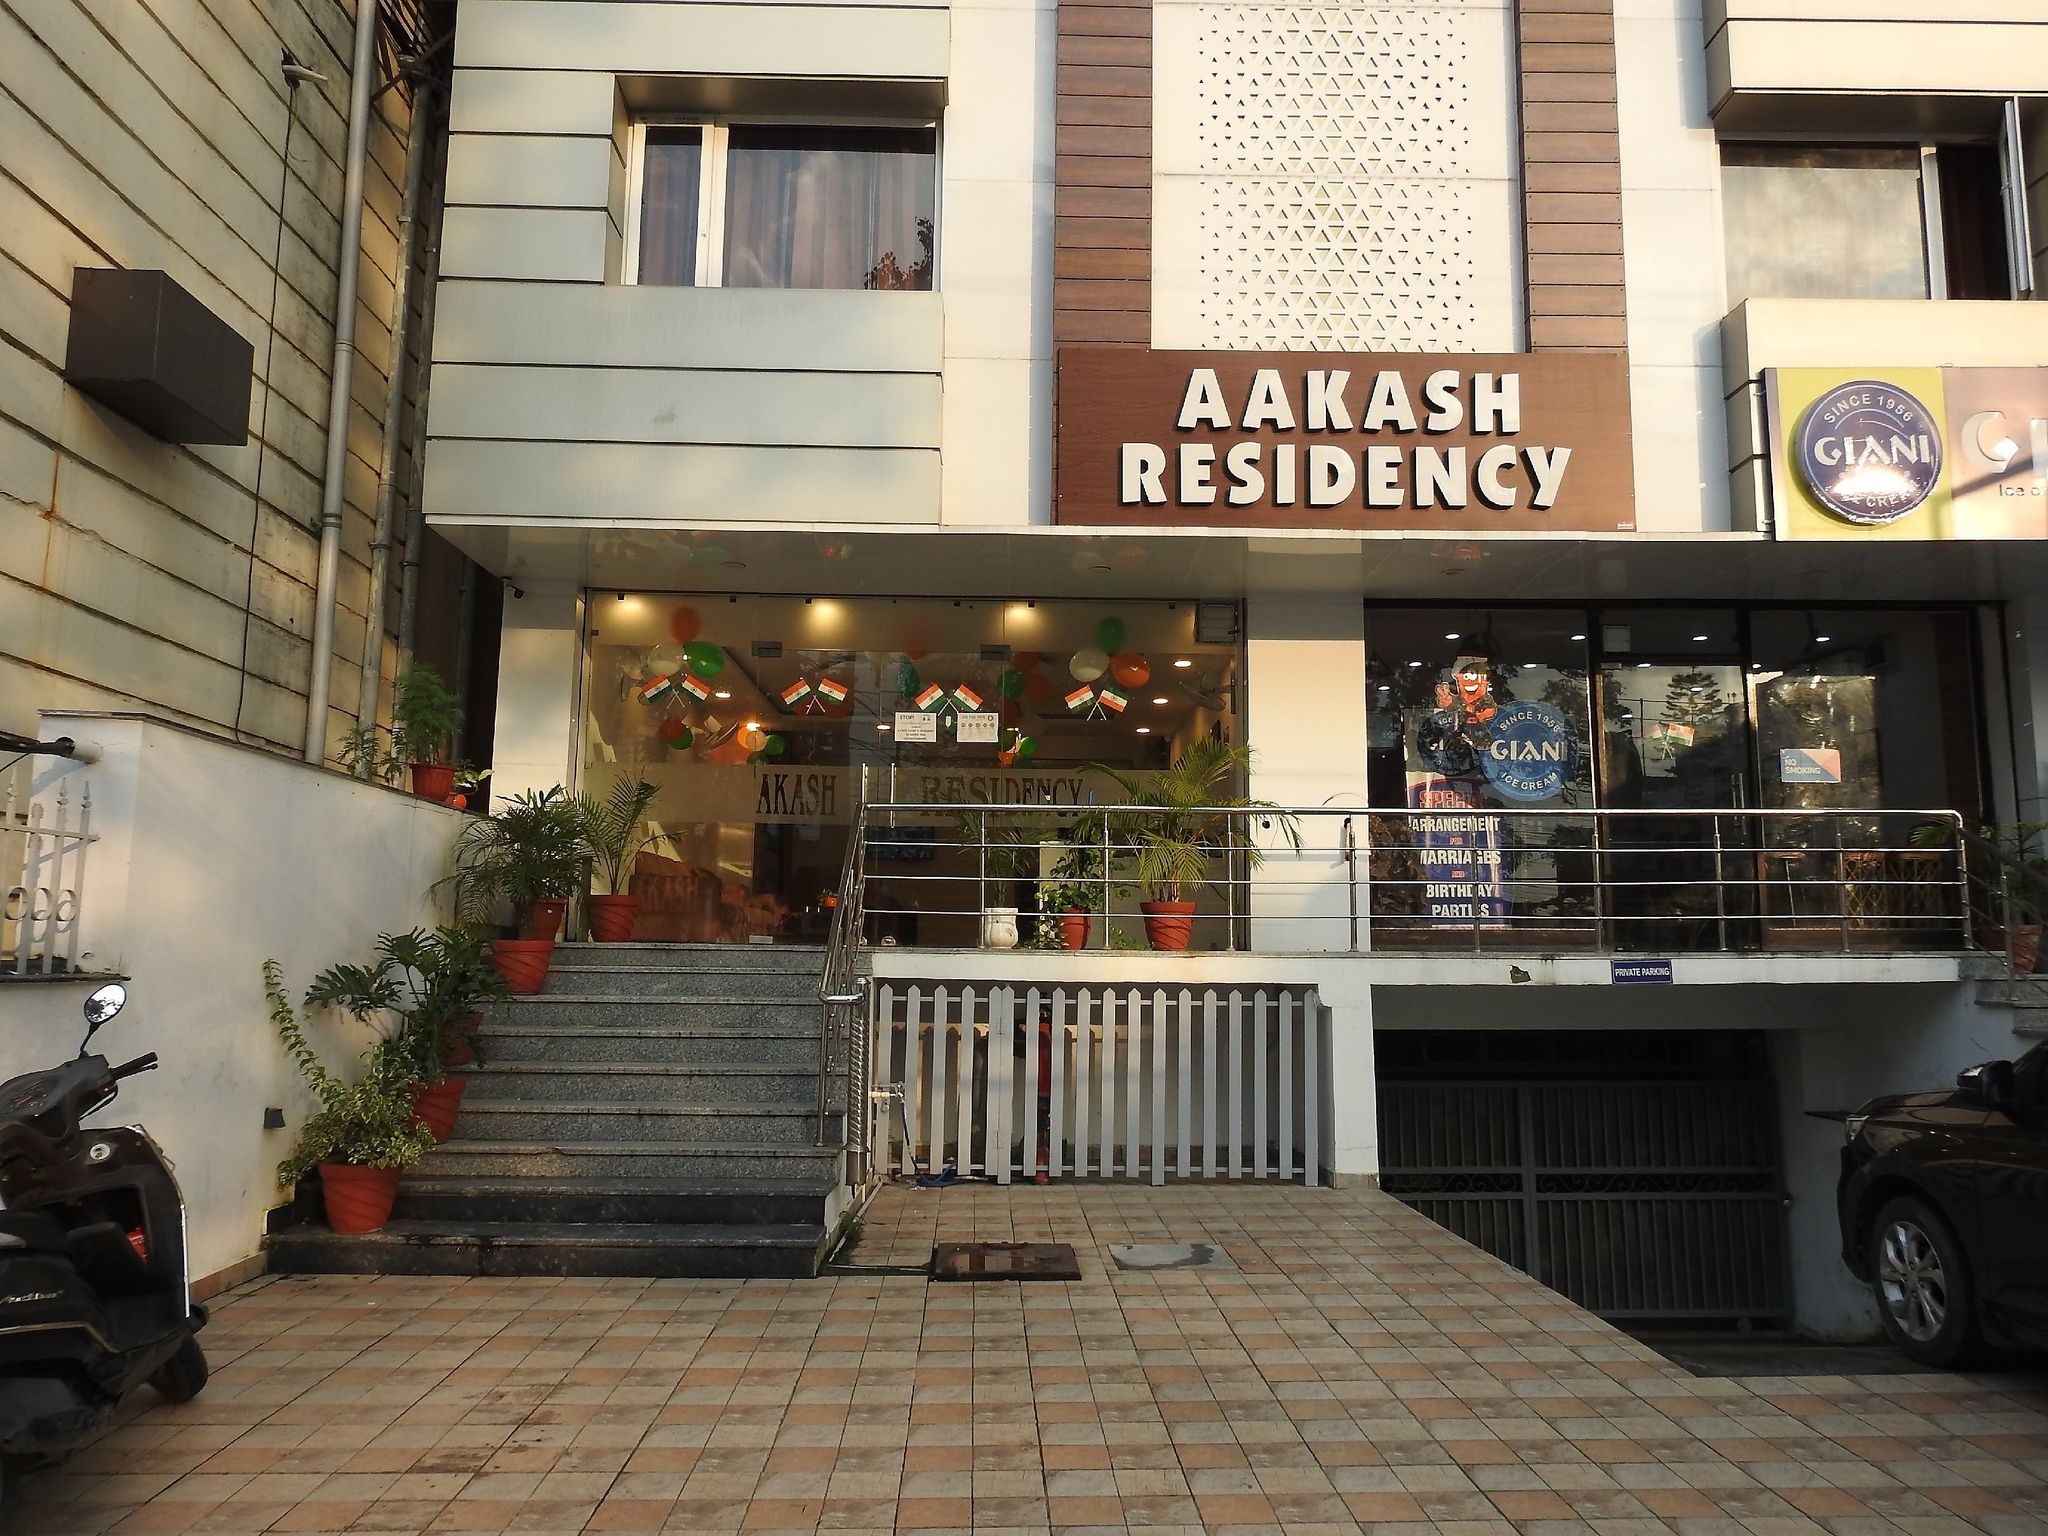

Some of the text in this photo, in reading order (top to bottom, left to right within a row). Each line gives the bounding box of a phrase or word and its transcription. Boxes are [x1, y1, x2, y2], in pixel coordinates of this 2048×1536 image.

[1177, 368, 1521, 434] AAKASH
[1823, 394, 1913, 423] SINCE 1956
[1814, 434, 1931, 466] GIANI
[1120, 441, 1572, 510] RESIDENCY
[1500, 711, 1533, 731] SINCE
[1490, 739, 1568, 762] GIANI
[1784, 766, 1821, 775] SMOKING
[1785, 758, 1797, 766] NO
[1501, 771, 1558, 790] ICE CREAM
[756, 773, 1085, 817] AKASH RESIDENCY
[1411, 817, 1501, 832] ARRANGEMENT
[1614, 967, 1670, 977] PRIVATE PARKING
